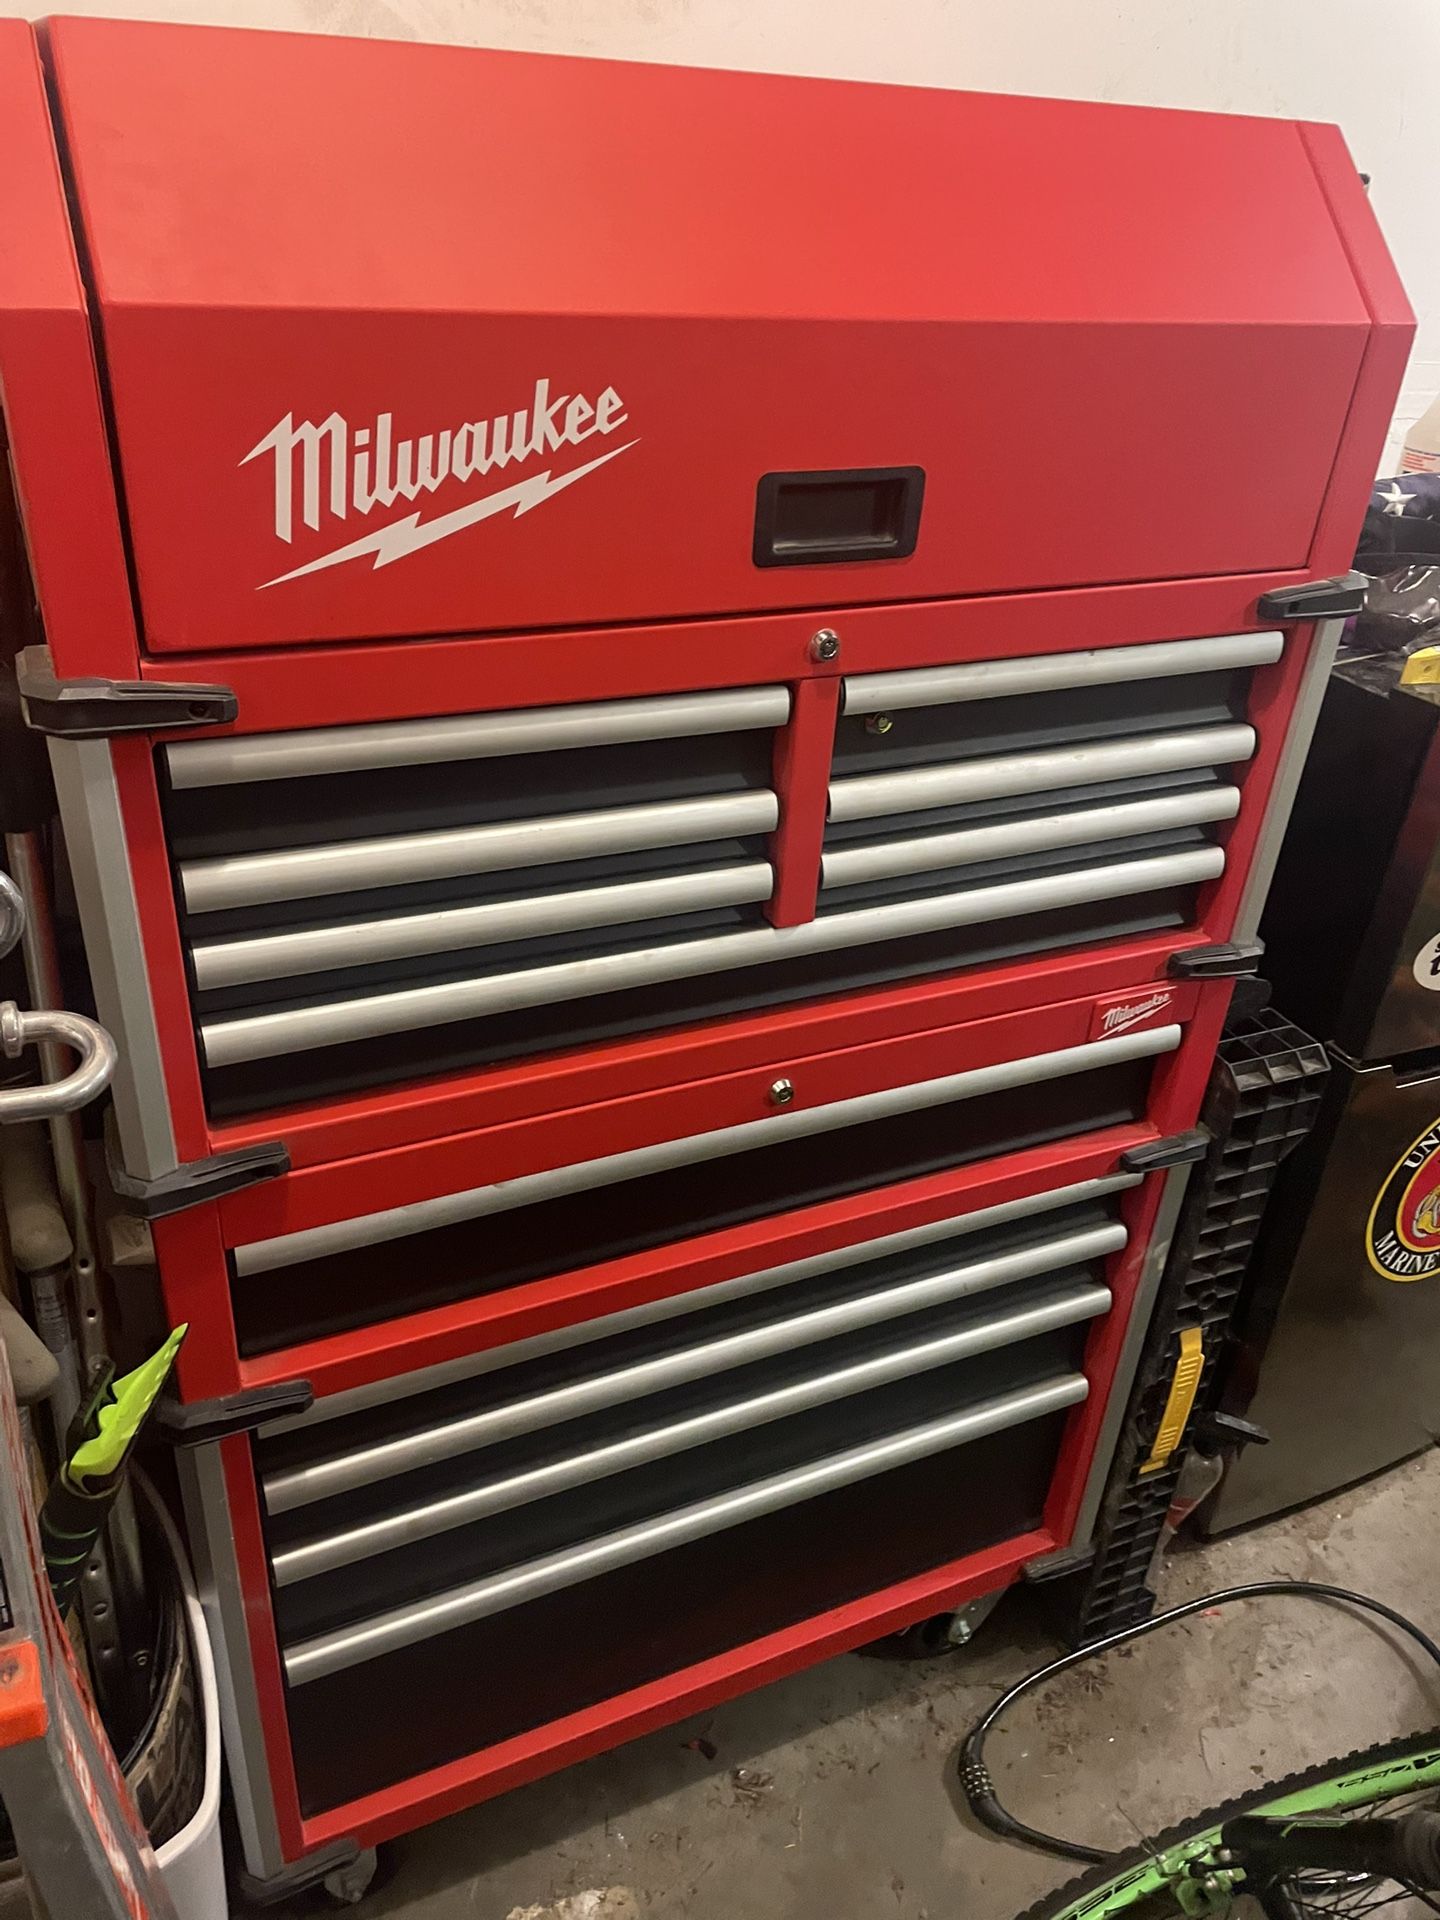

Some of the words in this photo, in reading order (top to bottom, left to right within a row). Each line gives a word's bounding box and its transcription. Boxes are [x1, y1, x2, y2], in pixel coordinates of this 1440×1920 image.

[237, 378, 629, 544] Milwaukee
[1402, 1125, 1440, 1169] UN
[1375, 1229, 1440, 1274] MARINE
